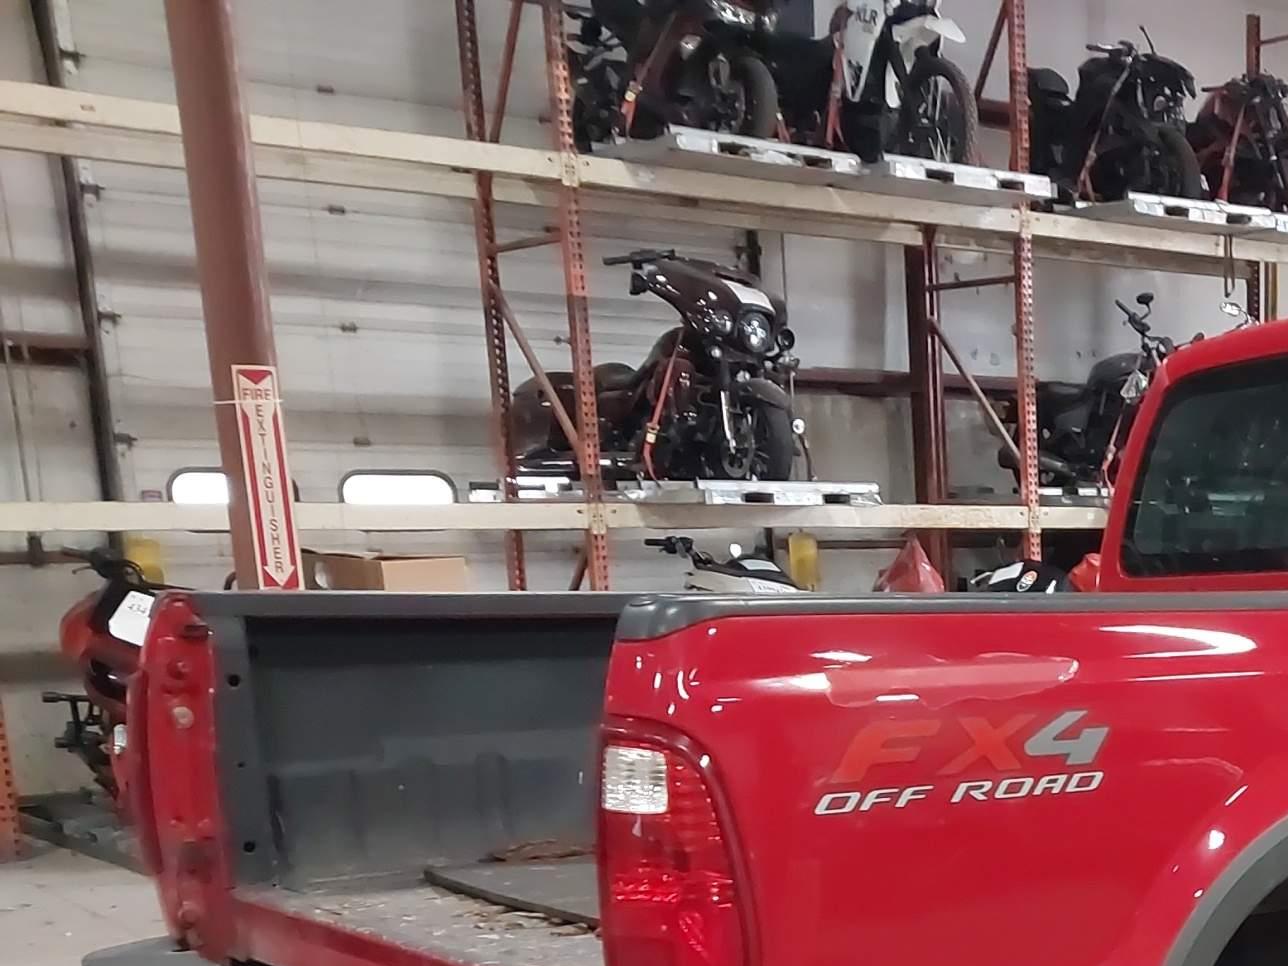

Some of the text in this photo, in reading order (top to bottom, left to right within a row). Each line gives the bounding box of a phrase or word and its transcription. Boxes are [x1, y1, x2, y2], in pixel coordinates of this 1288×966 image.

[241, 388, 272, 401] FIRE
[255, 404, 285, 574] EXTINGUISHER
[829, 709, 1110, 784] FX4
[814, 771, 1104, 815] OFF ROAD
